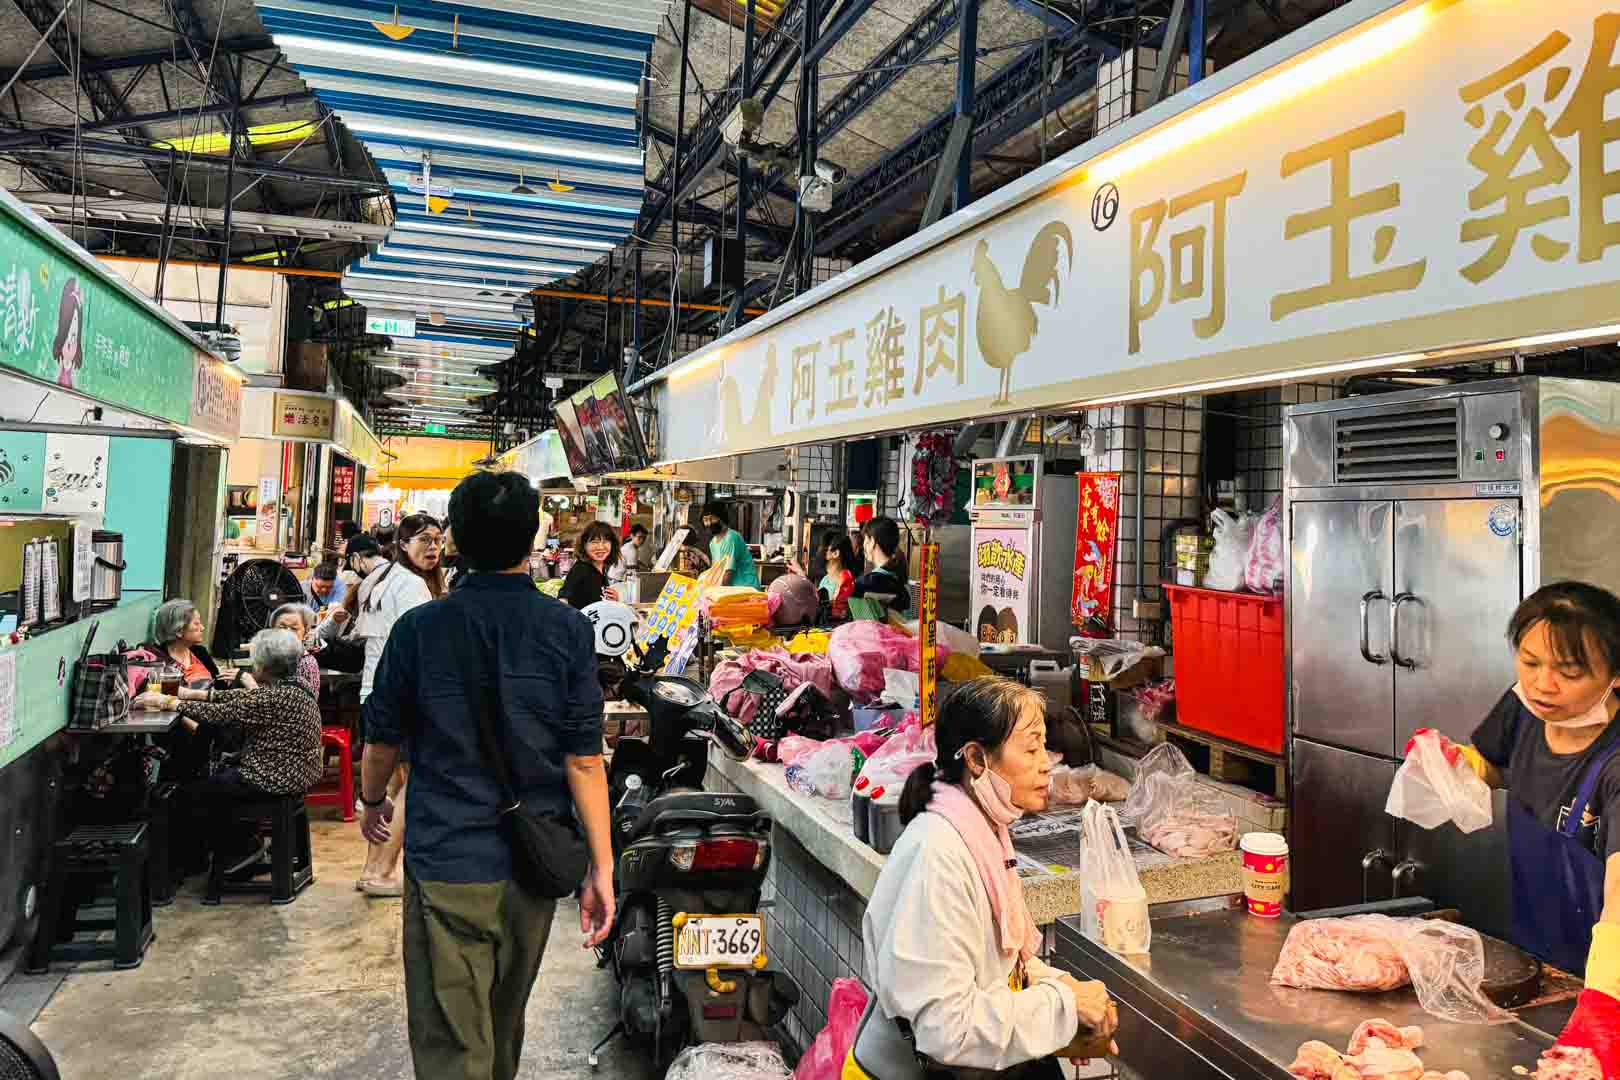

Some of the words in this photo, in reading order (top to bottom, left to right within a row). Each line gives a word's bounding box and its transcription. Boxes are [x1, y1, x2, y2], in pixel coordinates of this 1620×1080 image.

[1127, 12, 1620, 355] 阿玉雞
[789, 284, 967, 425] 阿玉雞肉
[712, 797, 736, 808] SYM
